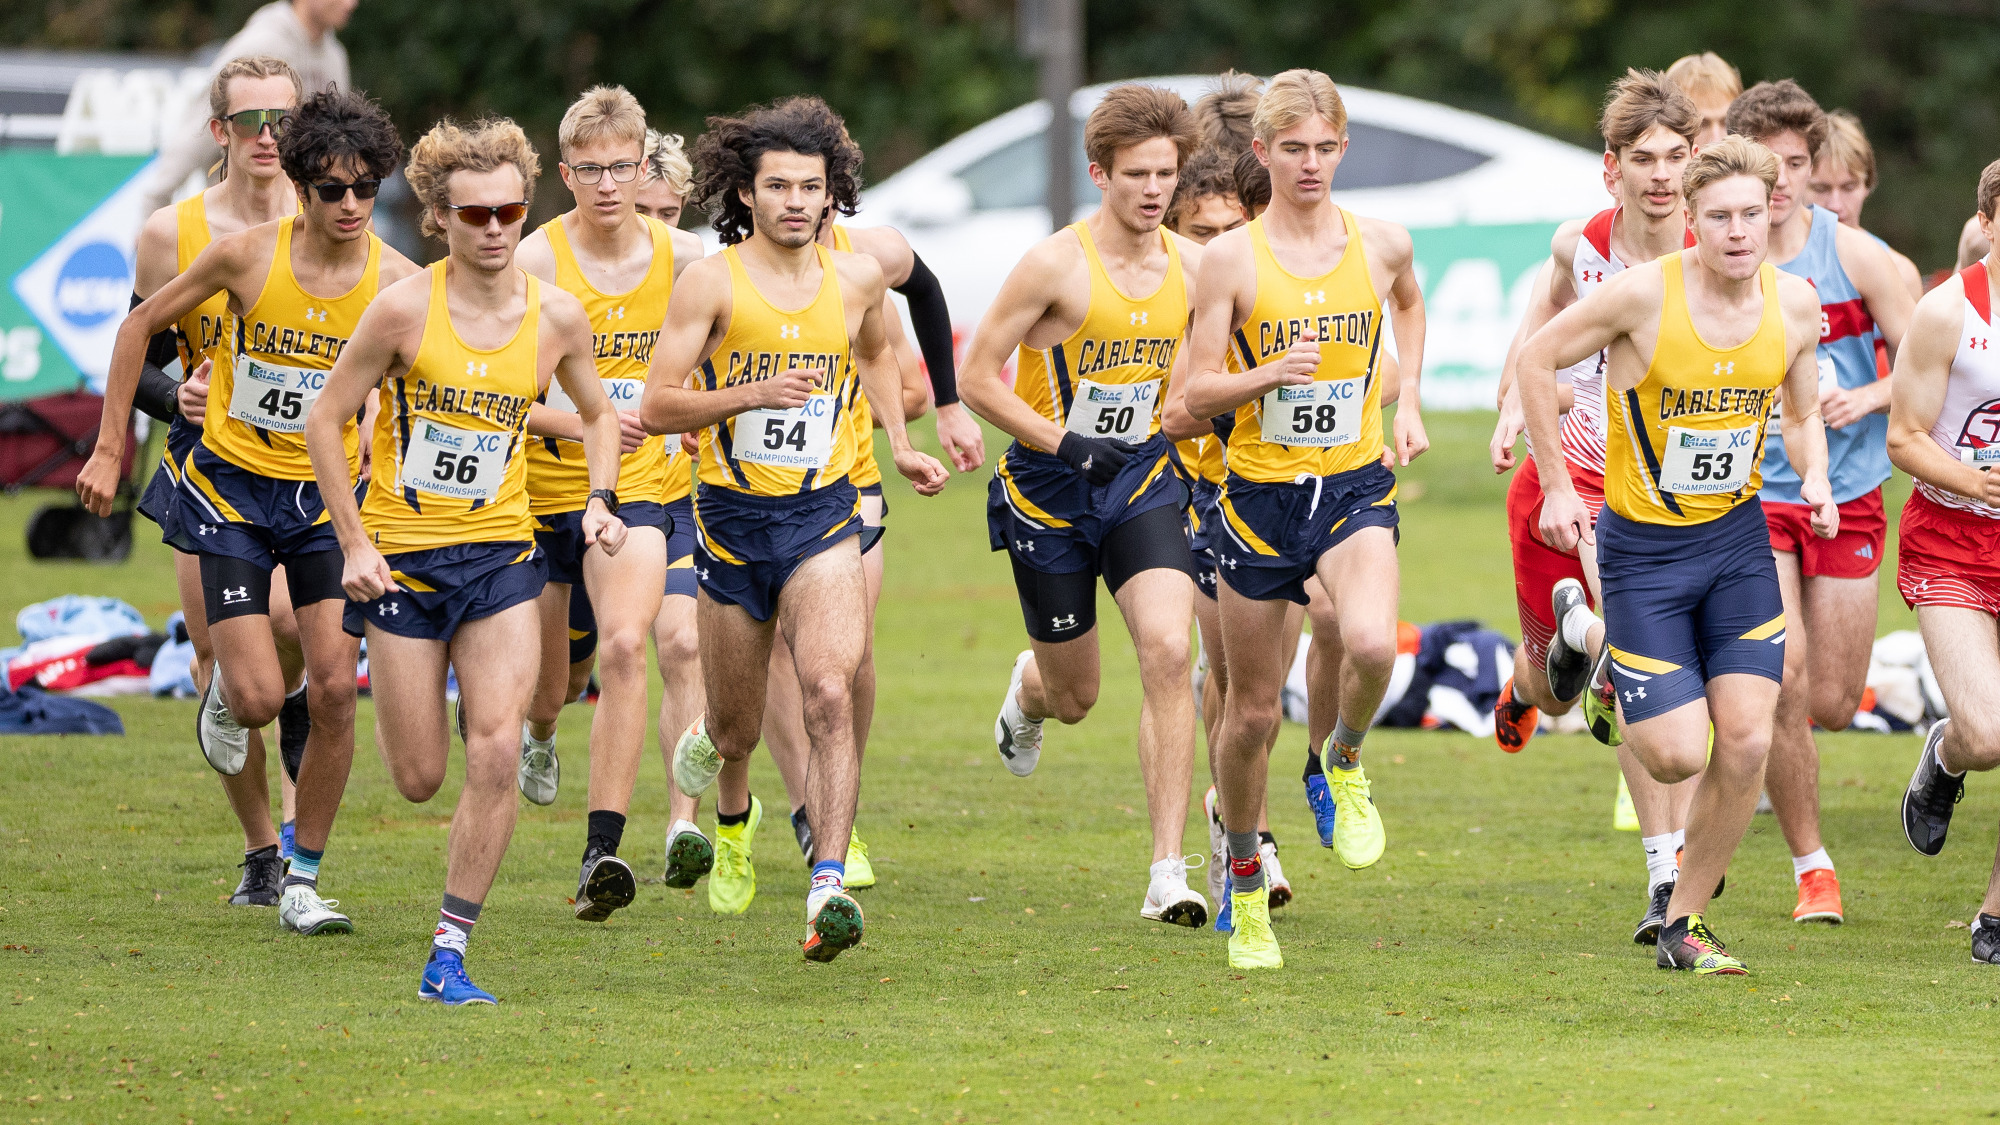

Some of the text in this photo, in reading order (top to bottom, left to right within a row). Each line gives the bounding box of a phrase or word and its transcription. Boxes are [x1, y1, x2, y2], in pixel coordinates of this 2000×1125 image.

[252, 367, 325, 390] MIAC XC
[608, 382, 635, 400] XC
[1092, 383, 1152, 403] MIAC XC
[1281, 382, 1354, 401] MIAC XC
[258, 388, 303, 420] 45
[413, 379, 528, 429] CARLETON
[1660, 386, 1772, 420] CARLETON
[240, 410, 306, 431] CHAMPIONSHI
[1094, 406, 1135, 435] 50
[1291, 404, 1336, 434] 58
[428, 429, 501, 452] MIAC XC
[763, 418, 807, 452] 54
[1274, 433, 1349, 444] CHAMPIONSHIPS
[1683, 429, 1752, 449] MIAC XC
[744, 450, 819, 465] CHAMPIONSHIPS
[1978, 449, 2000, 459] MIA
[432, 450, 480, 484] 56
[1691, 452, 1734, 481] 53
[412, 477, 488, 496] CHAMPIONSHIPS
[1671, 480, 1742, 492] CHAMPIONSHIPS
